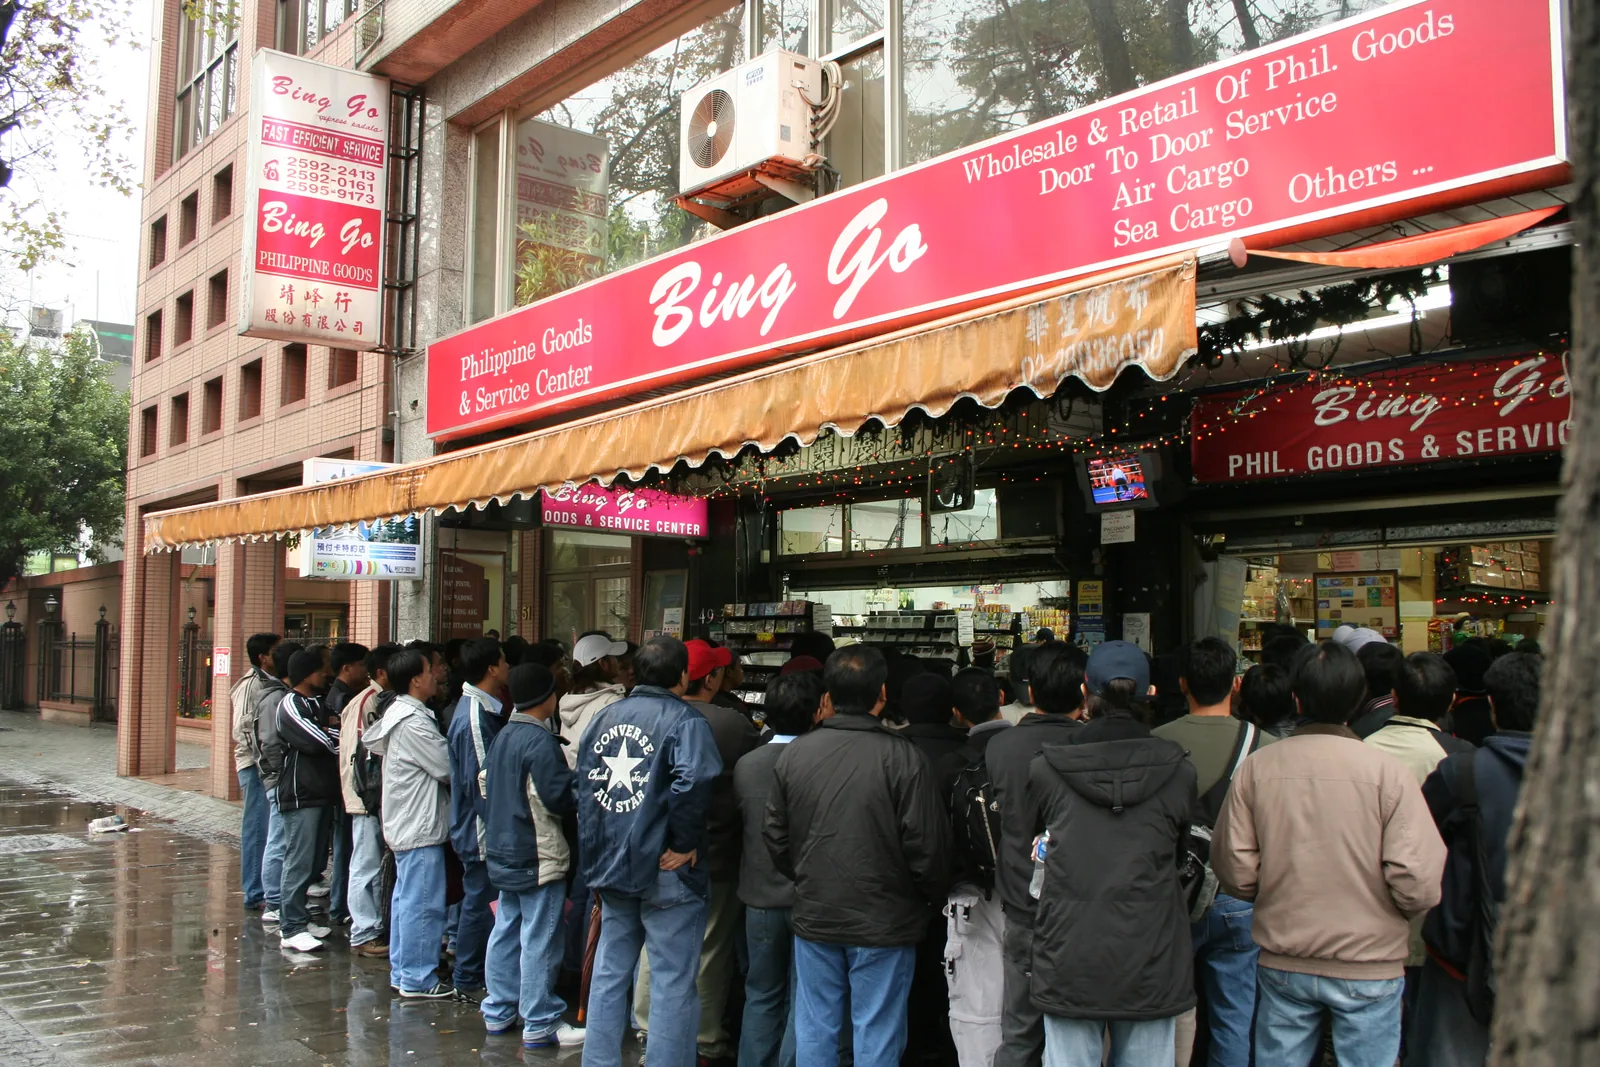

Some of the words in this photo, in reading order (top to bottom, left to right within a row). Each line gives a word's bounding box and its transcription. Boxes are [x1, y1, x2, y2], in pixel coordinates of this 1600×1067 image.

[272, 75, 331, 113] Bing
[347, 94, 379, 118] Go
[962, 130, 1078, 185] Wholesale
[1087, 118, 1109, 146] &
[1119, 88, 1199, 137] Retail
[1216, 68, 1249, 105] Of
[1265, 48, 1338, 91] Phil.
[1352, 10, 1456, 61] Goods
[262, 123, 289, 142] FAST
[292, 130, 340, 152] EFFICIENT
[343, 140, 381, 161] SERVICE
[1039, 160, 1095, 196] Door
[1106, 144, 1139, 175] To
[1150, 125, 1214, 164] Door
[1226, 92, 1338, 139] Service
[286, 168, 374, 192] 2592-0161
[287, 156, 375, 181] 2592-2413
[1111, 181, 1156, 211] Air
[1167, 156, 1249, 194] Cargo
[1289, 159, 1398, 203] Others
[286, 180, 375, 204] 2595-9173
[262, 201, 325, 248] Bing
[339, 218, 374, 255] Go
[1114, 219, 1158, 248] Sea
[1170, 196, 1254, 233] Cargo
[259, 250, 330, 276] PHILIPPINE
[333, 263, 373, 283] GOOD'S
[649, 261, 796, 347] Bing
[827, 198, 928, 320] Go
[279, 284, 353, 313] 靖峰行
[264, 308, 363, 335] 股份有限公司
[461, 341, 536, 382] Philippine
[542, 318, 592, 355] Goods
[459, 391, 470, 416] &
[475, 383, 530, 413] Service
[536, 364, 592, 396] Center
[1312, 386, 1443, 432] Bing
[1493, 355, 1571, 417] Go
[1229, 449, 1294, 477] PHIL.
[1307, 437, 1405, 471] GOODS
[1421, 434, 1440, 459] &
[555, 483, 608, 511] Bing
[617, 492, 648, 514] Go
[585, 514, 593, 526] &
[600, 516, 650, 531] SERVICE
[656, 521, 701, 535] CENTER
[522, 606, 531, 621] 51
[594, 724, 654, 755] CONVERSE
[594, 788, 612, 811] ALL
[616, 790, 645, 812] STAR
